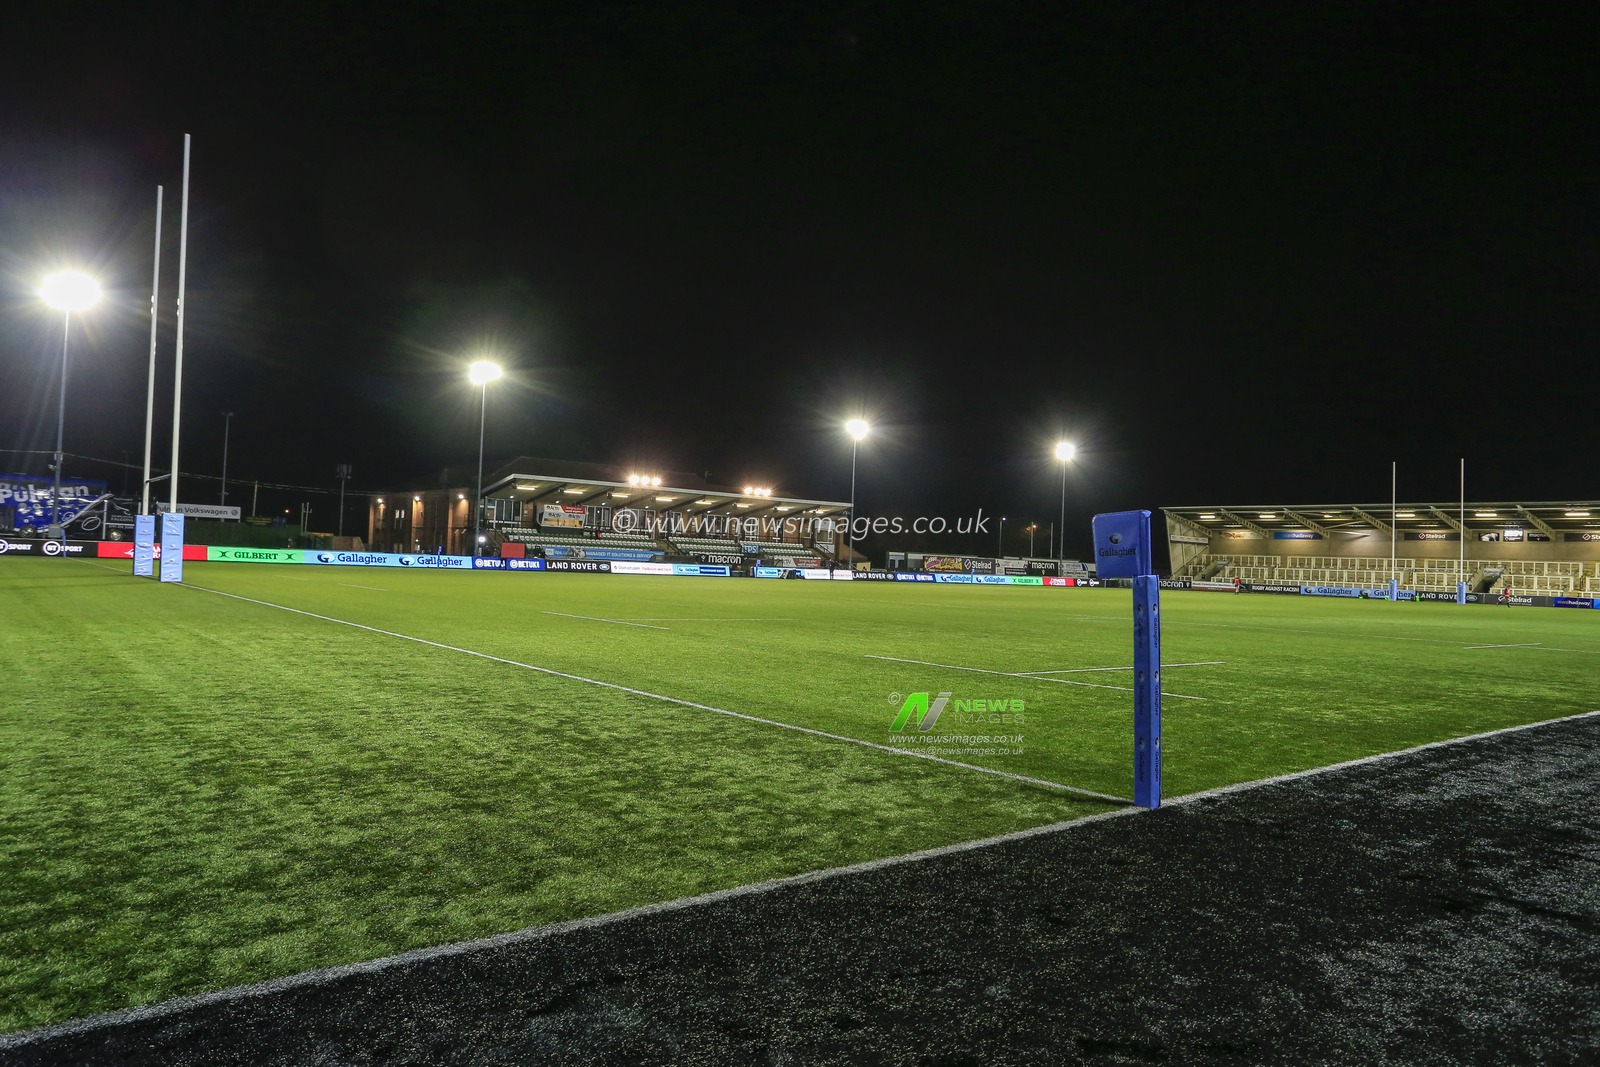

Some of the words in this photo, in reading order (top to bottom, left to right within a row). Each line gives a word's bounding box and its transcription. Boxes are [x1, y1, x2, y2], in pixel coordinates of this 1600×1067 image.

[184, 506, 228, 516] Volkswagen
[234, 550, 278, 560] GILBERT
[1098, 546, 1137, 557] Gallagher
[337, 553, 387, 564] Gallagher
[417, 556, 463, 566] Gallagher
[708, 554, 742, 564] macron
[546, 561, 568, 569] LAND
[570, 562, 597, 570] ROVER
[971, 560, 992, 570] Stelrad
[1031, 561, 1055, 570] macron
[984, 576, 1006, 584] Gallagher
[1317, 587, 1352, 596] Gallagher
